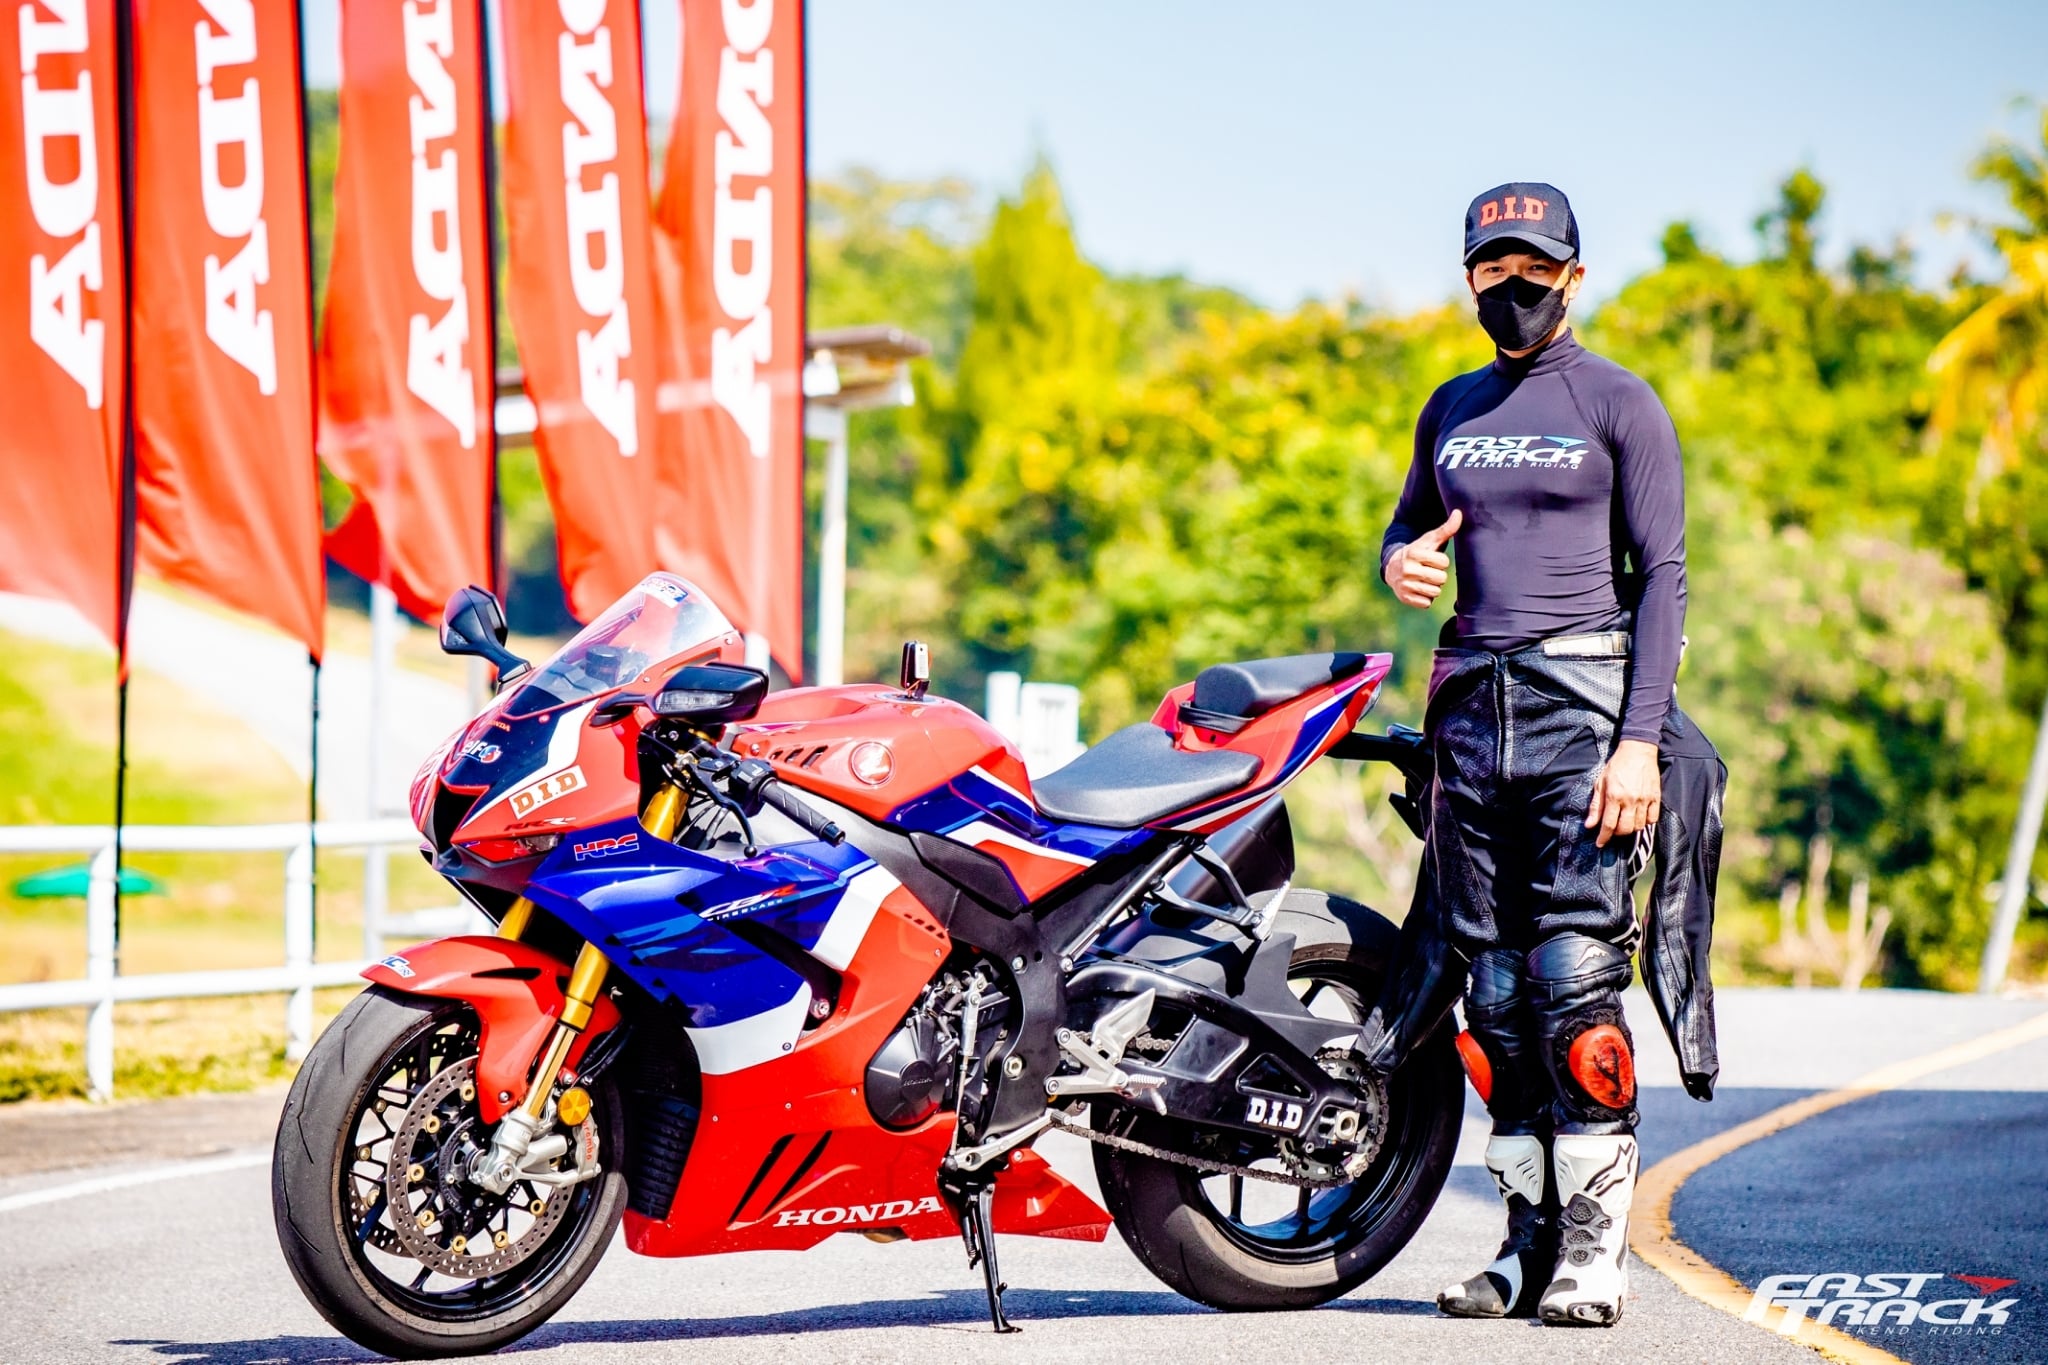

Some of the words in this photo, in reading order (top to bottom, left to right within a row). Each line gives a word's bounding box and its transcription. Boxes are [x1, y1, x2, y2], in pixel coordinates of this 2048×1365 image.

[1480, 196, 1544, 227] D.I.D
[1437, 436, 1541, 465] FAST
[1447, 448, 1589, 470] TRACK
[1530, 462, 1579, 470] RIDING
[513, 772, 578, 815] D.I.D
[573, 833, 640, 861] HRC
[1247, 1097, 1303, 1130] D.I.D
[773, 1196, 943, 1227] HONDA
